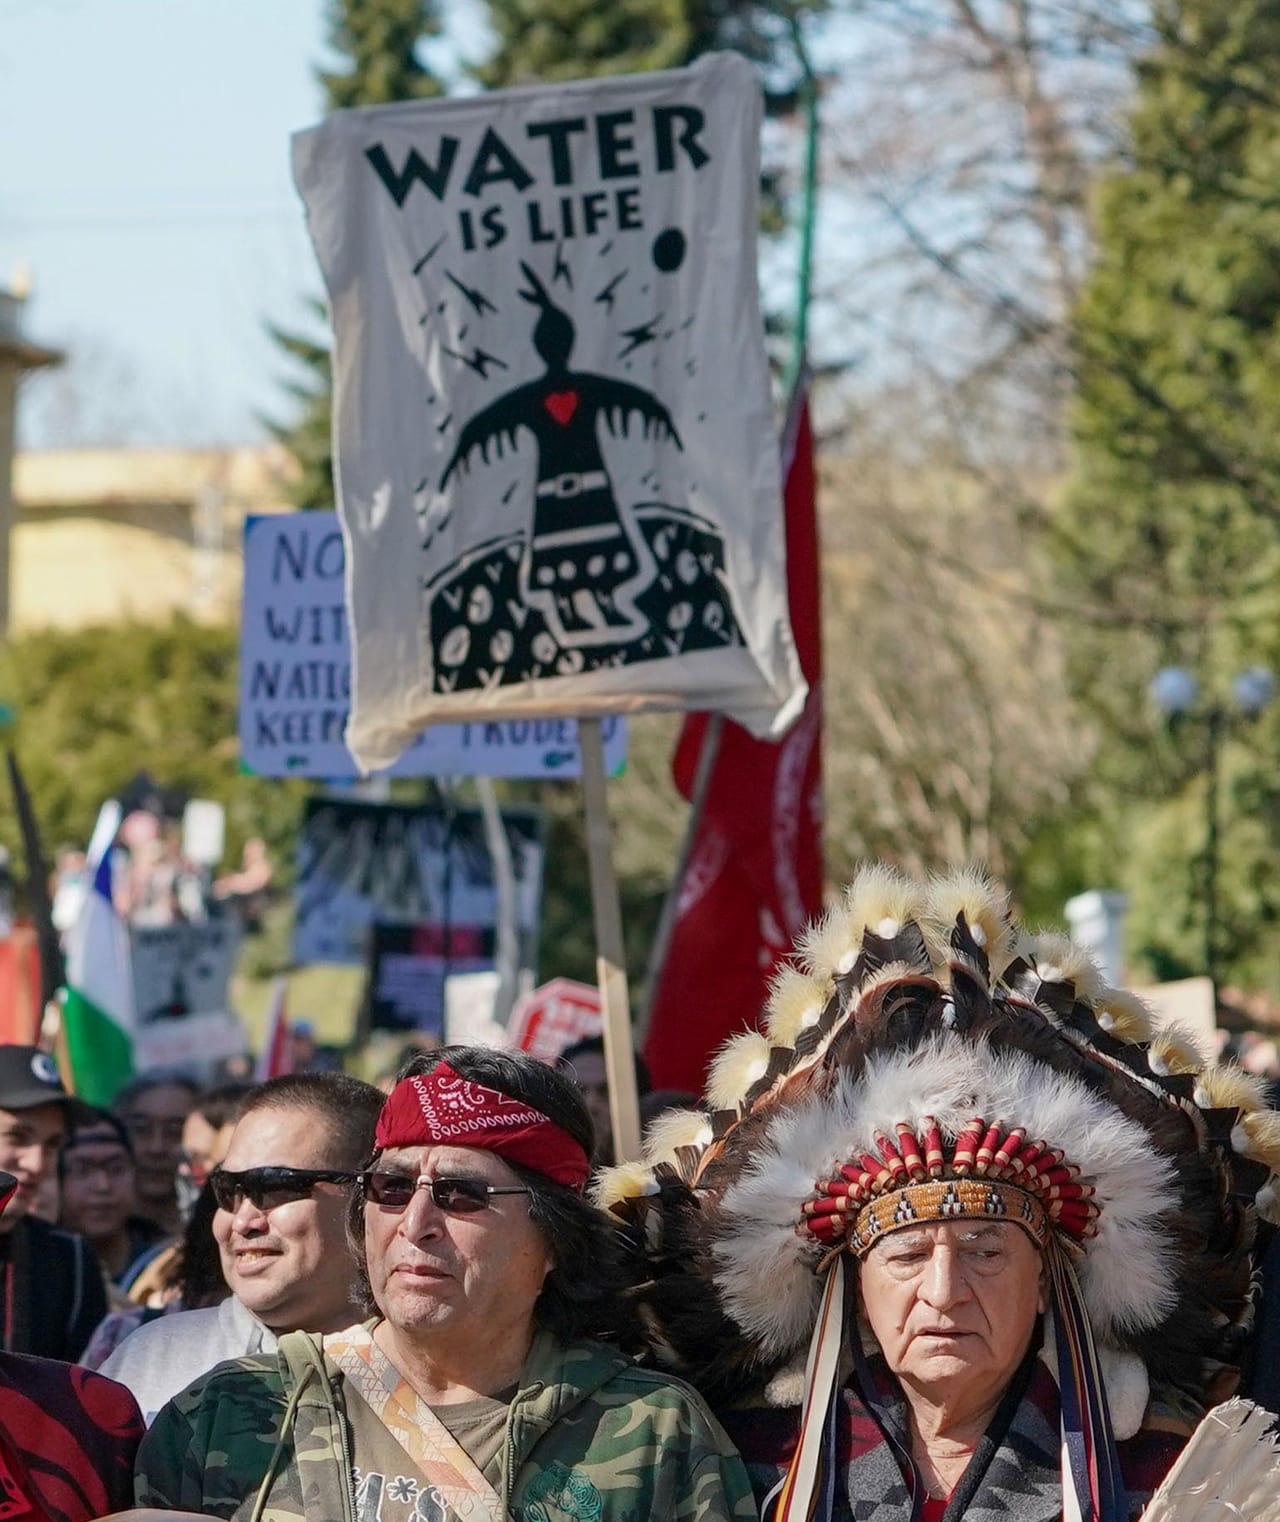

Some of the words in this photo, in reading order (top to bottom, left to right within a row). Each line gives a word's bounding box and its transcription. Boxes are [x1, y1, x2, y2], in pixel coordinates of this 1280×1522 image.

[363, 104, 712, 208] WATER
[458, 207, 507, 252] IS
[527, 188, 644, 243] LIFE
[265, 605, 346, 646] WIT
[249, 660, 351, 701] NATI
[461, 715, 616, 749] TRUDEU
